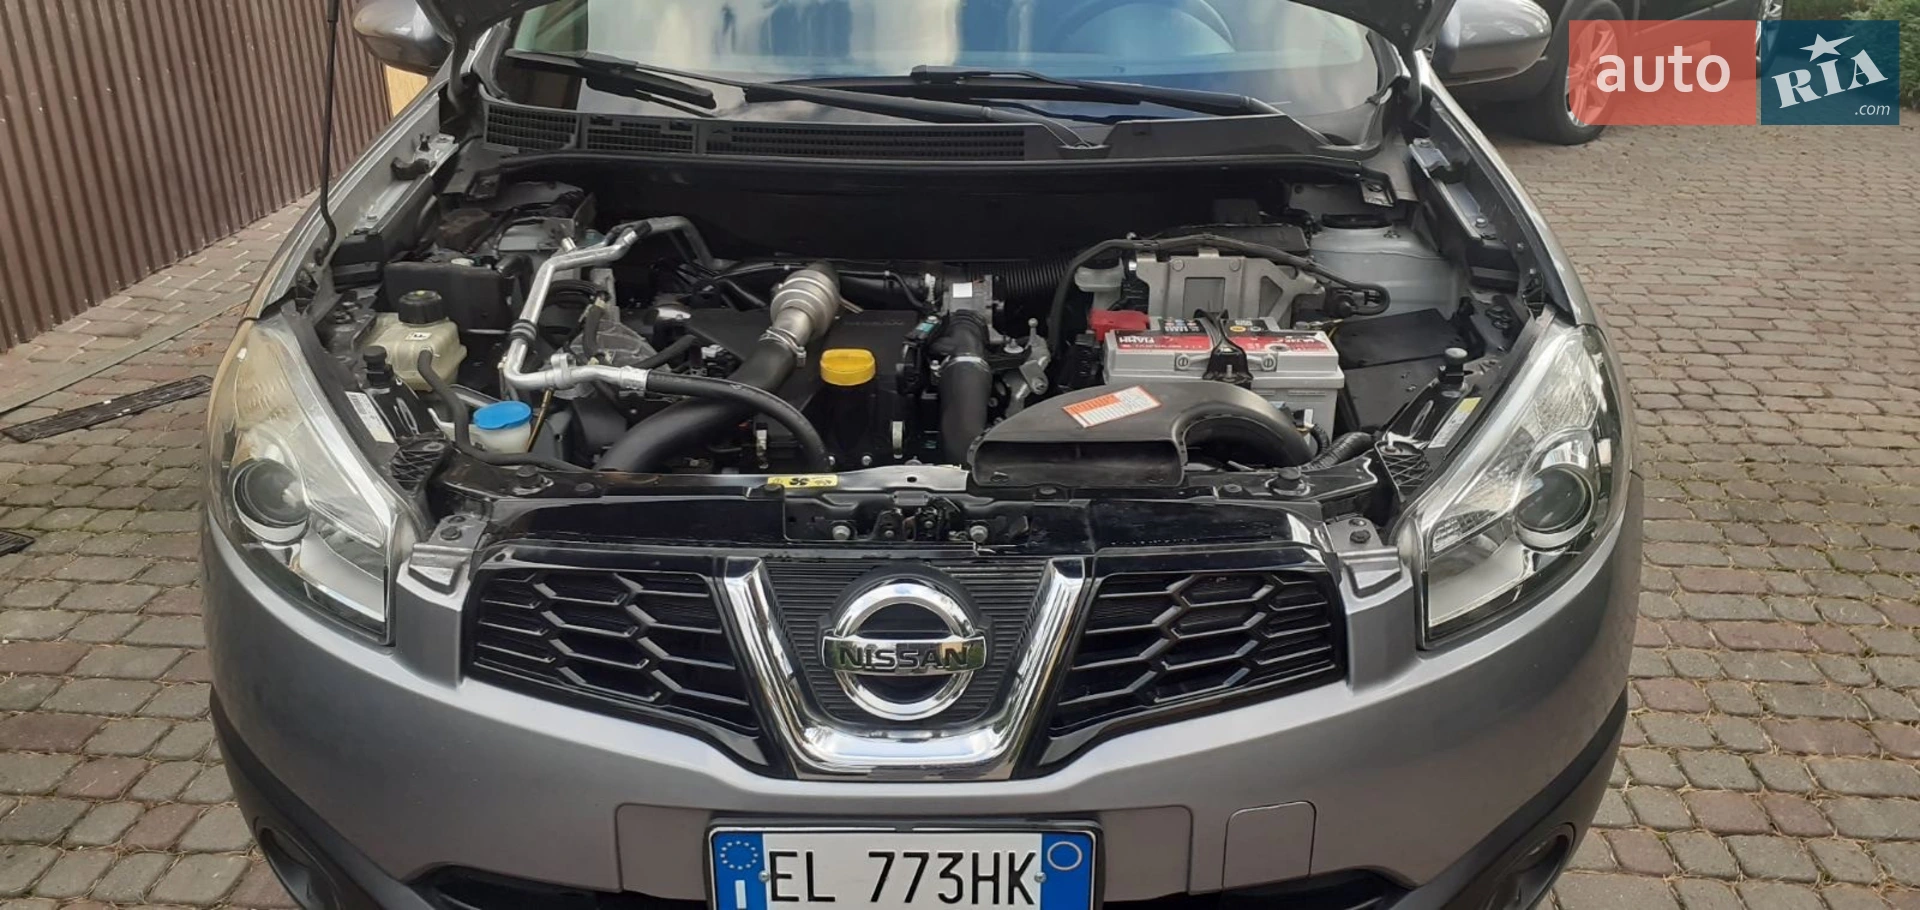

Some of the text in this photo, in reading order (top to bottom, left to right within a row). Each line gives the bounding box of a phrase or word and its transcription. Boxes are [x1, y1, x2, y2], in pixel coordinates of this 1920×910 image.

[839, 648, 968, 670] NISSAN
[768, 850, 1037, 905] EL 773HK
